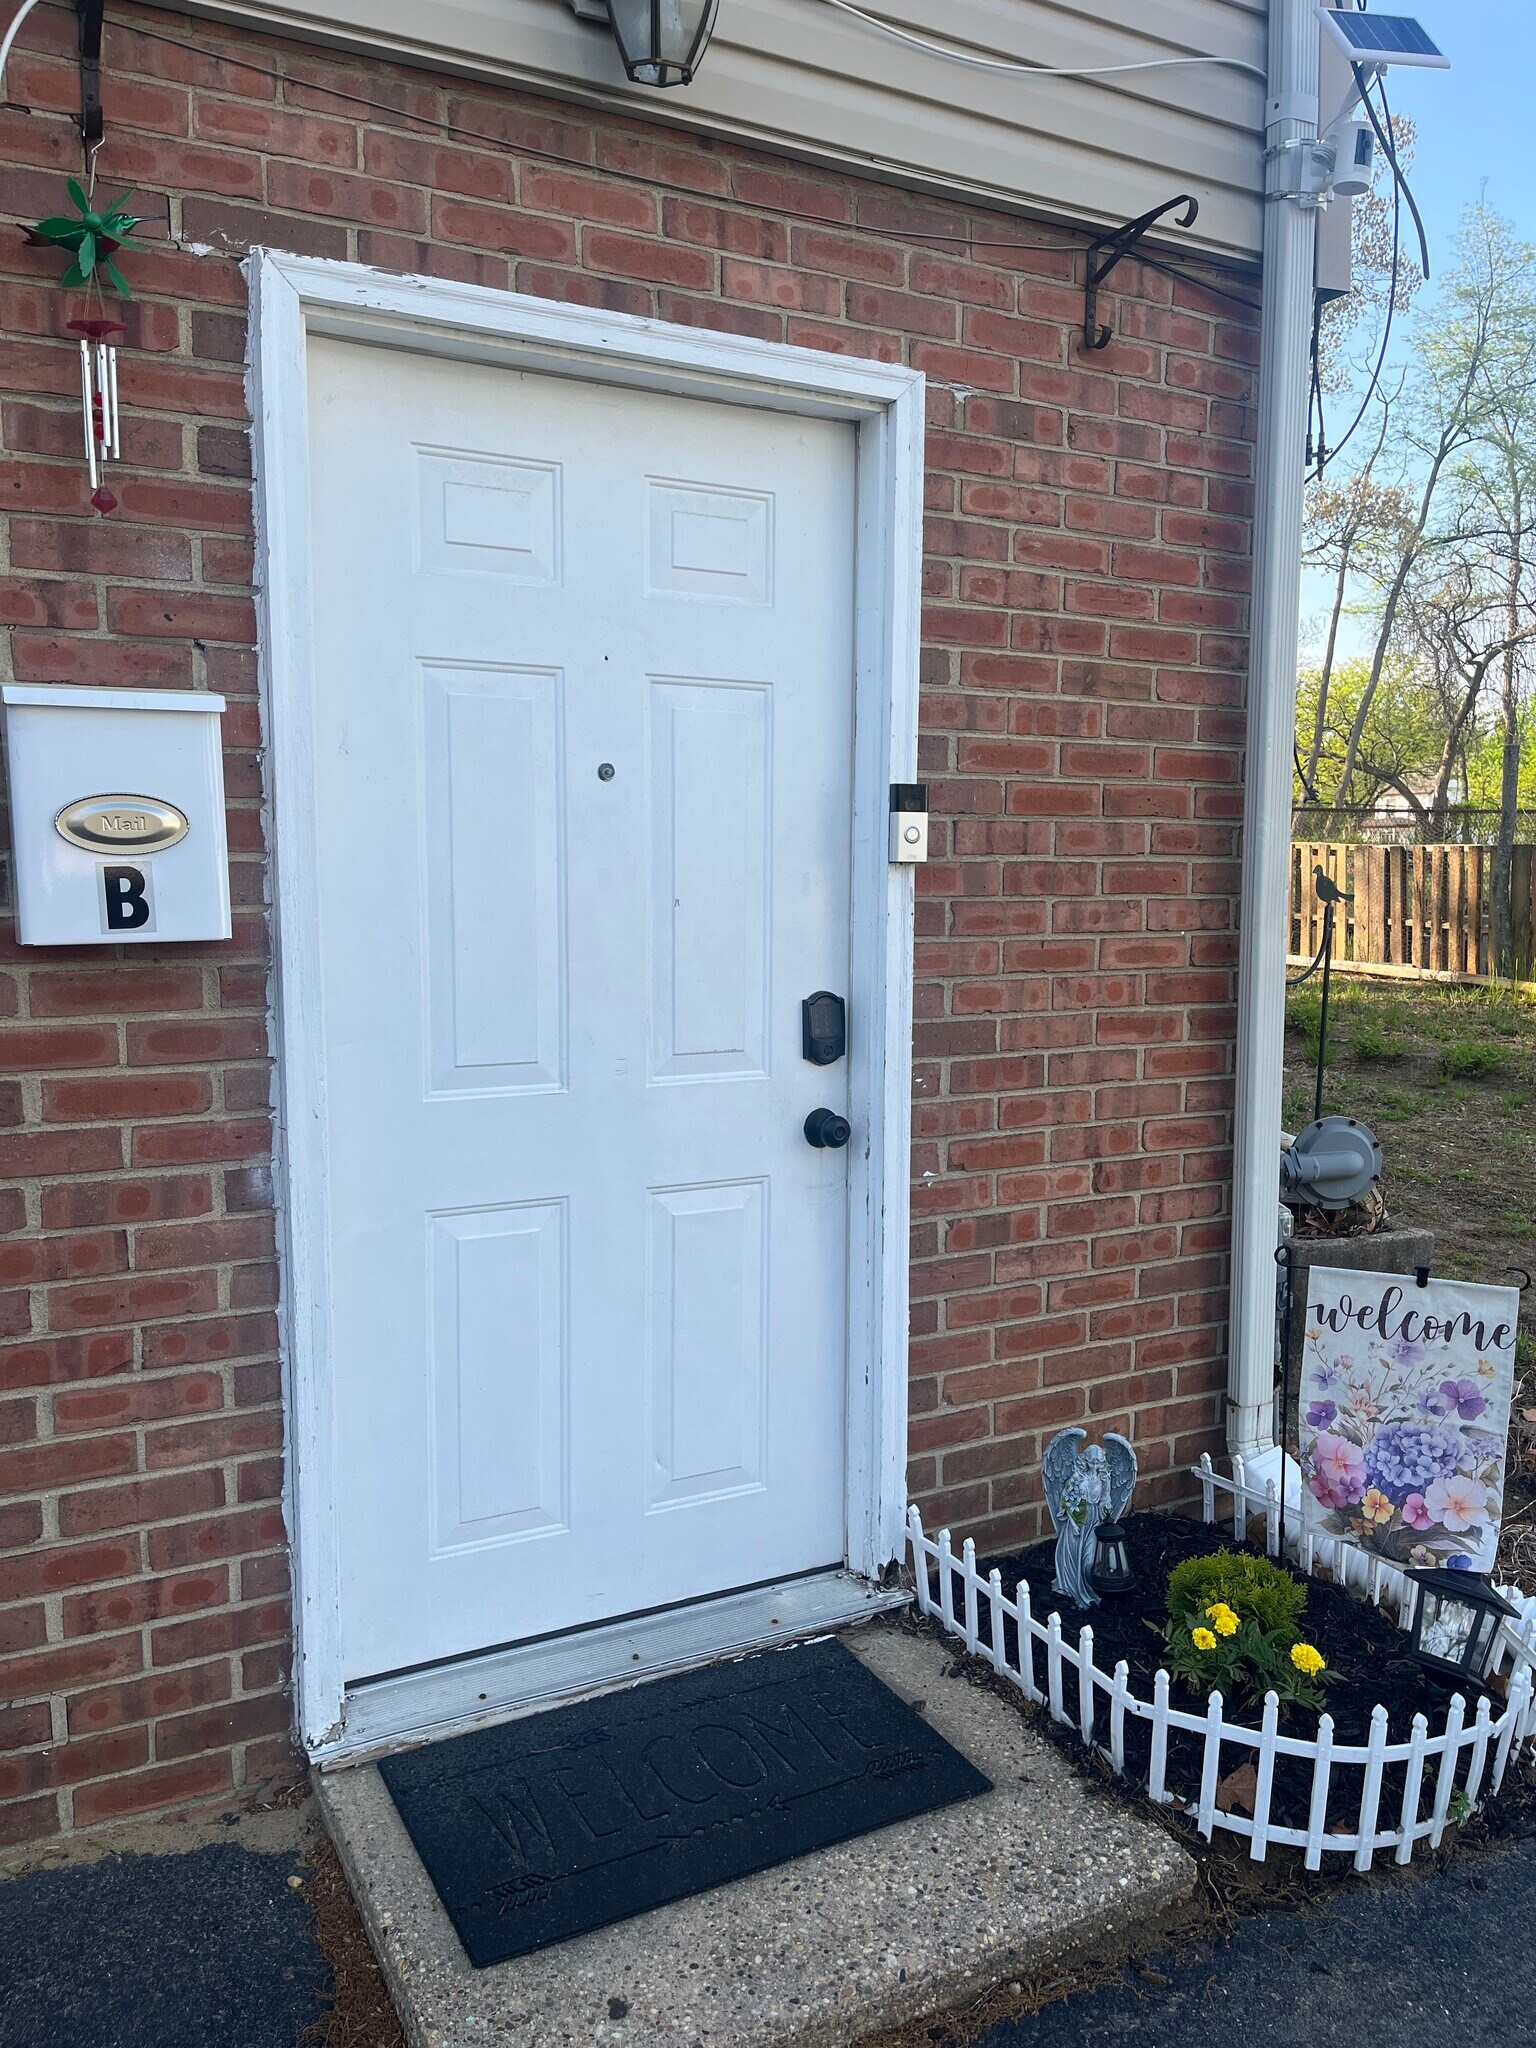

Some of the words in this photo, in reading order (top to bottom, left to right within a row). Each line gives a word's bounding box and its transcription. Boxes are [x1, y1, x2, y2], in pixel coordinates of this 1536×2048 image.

[100, 815, 147, 831] Mail
[103, 865, 150, 930] B
[1306, 1286, 1517, 1351] welcome
[470, 1692, 884, 1863] WELCOME
